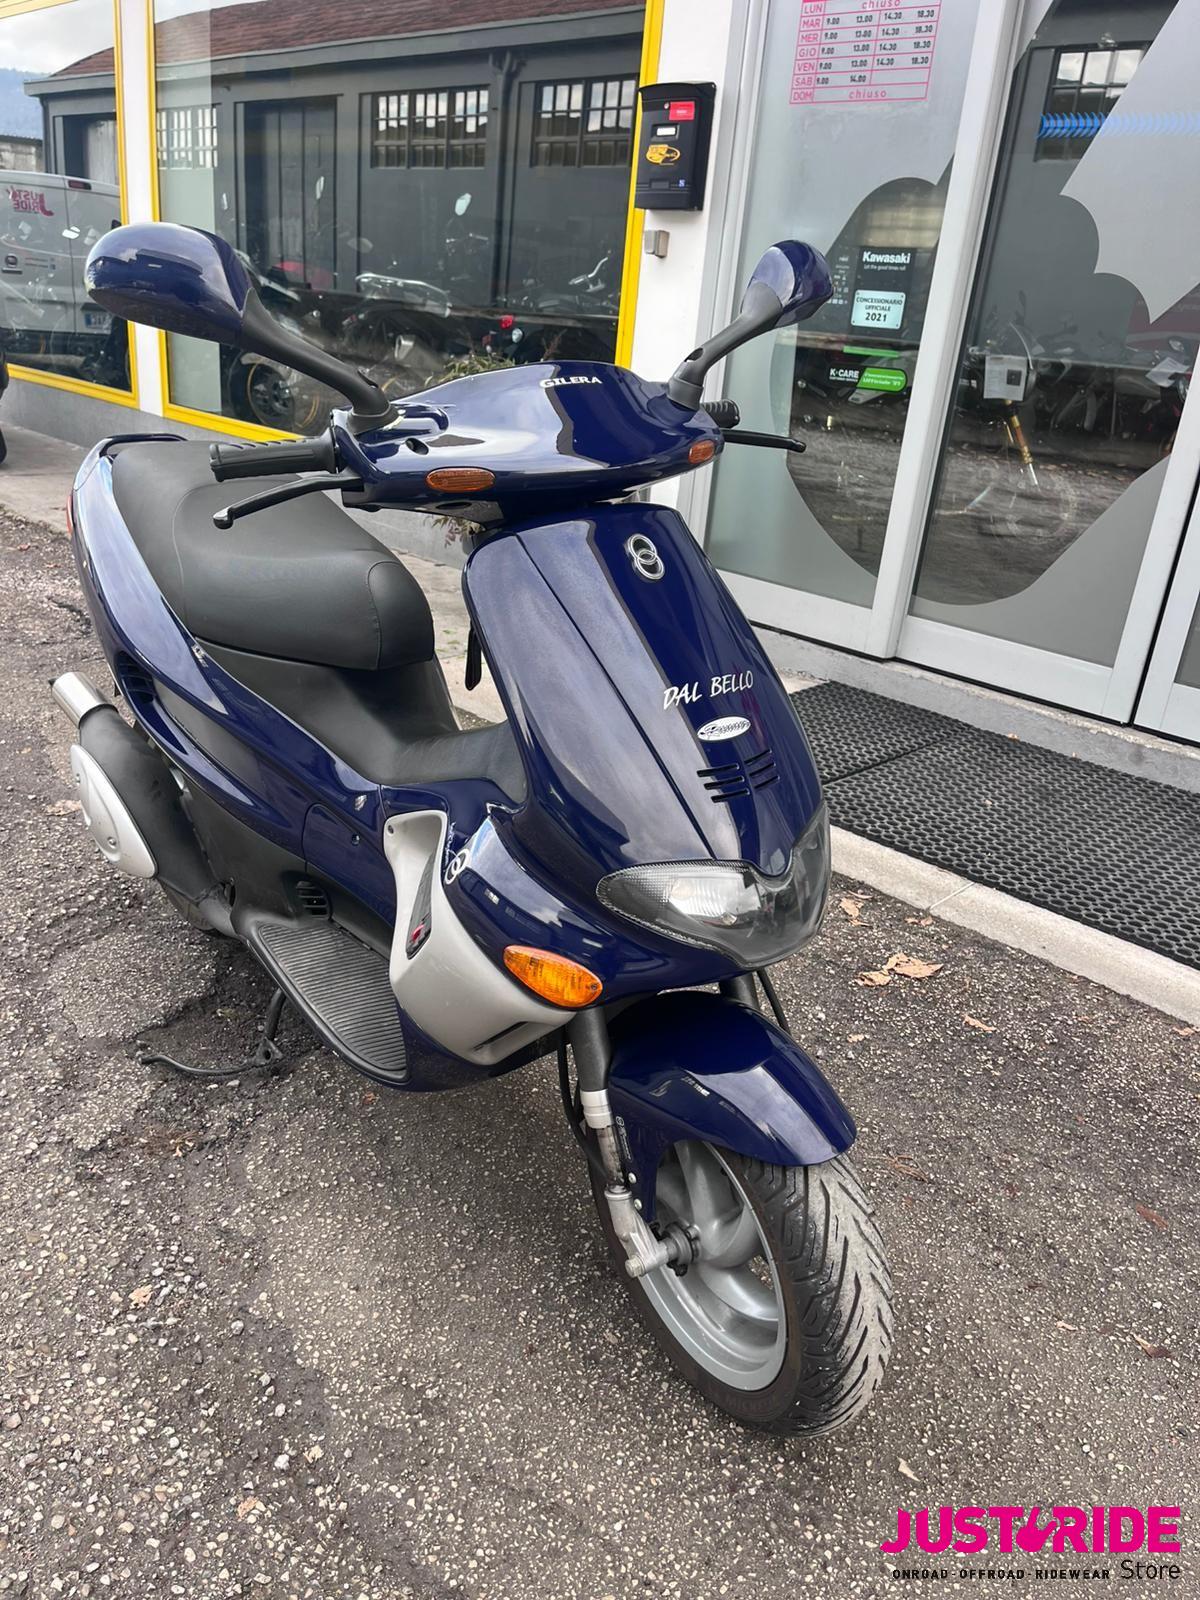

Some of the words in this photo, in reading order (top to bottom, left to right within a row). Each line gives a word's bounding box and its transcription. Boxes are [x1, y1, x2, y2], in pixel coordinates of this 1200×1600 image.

[804, 3, 823, 14] LUN
[862, 0, 900, 9] chiuso
[802, 18, 821, 28] MAR
[826, 17, 840, 25] 9.00
[856, 15, 873, 23] 13.00
[884, 12, 902, 20] 14.30
[917, 9, 934, 18] 18.30
[801, 33, 819, 43] MER
[824, 32, 838, 40] 9.00
[855, 30, 872, 38] 13.00
[882, 28, 900, 36] 14.30
[915, 25, 933, 33] 18.30
[799, 47, 816, 57] GIO
[821, 47, 834, 55] 9.00
[853, 44, 870, 52] 13.00
[879, 43, 897, 51] 14.30
[913, 40, 931, 49] 18.30
[797, 62, 815, 72] VEN
[819, 62, 832, 70] 9.00
[851, 59, 868, 67] 13.00
[876, 58, 894, 66] 14.30
[911, 56, 929, 65] 18.30
[794, 77, 812, 86] SAB
[850, 75, 866, 83] 14.00
[793, 91, 812, 101] DOM
[849, 89, 887, 99] chiuso
[862, 251, 910, 264] Kawasaki
[856, 297, 903, 305] CONCESSIONARIO
[865, 312, 887, 322] 2021
[539, 376, 603, 388] GILERA
[663, 681, 702, 710] DAL
[710, 670, 754, 698] BELLO
